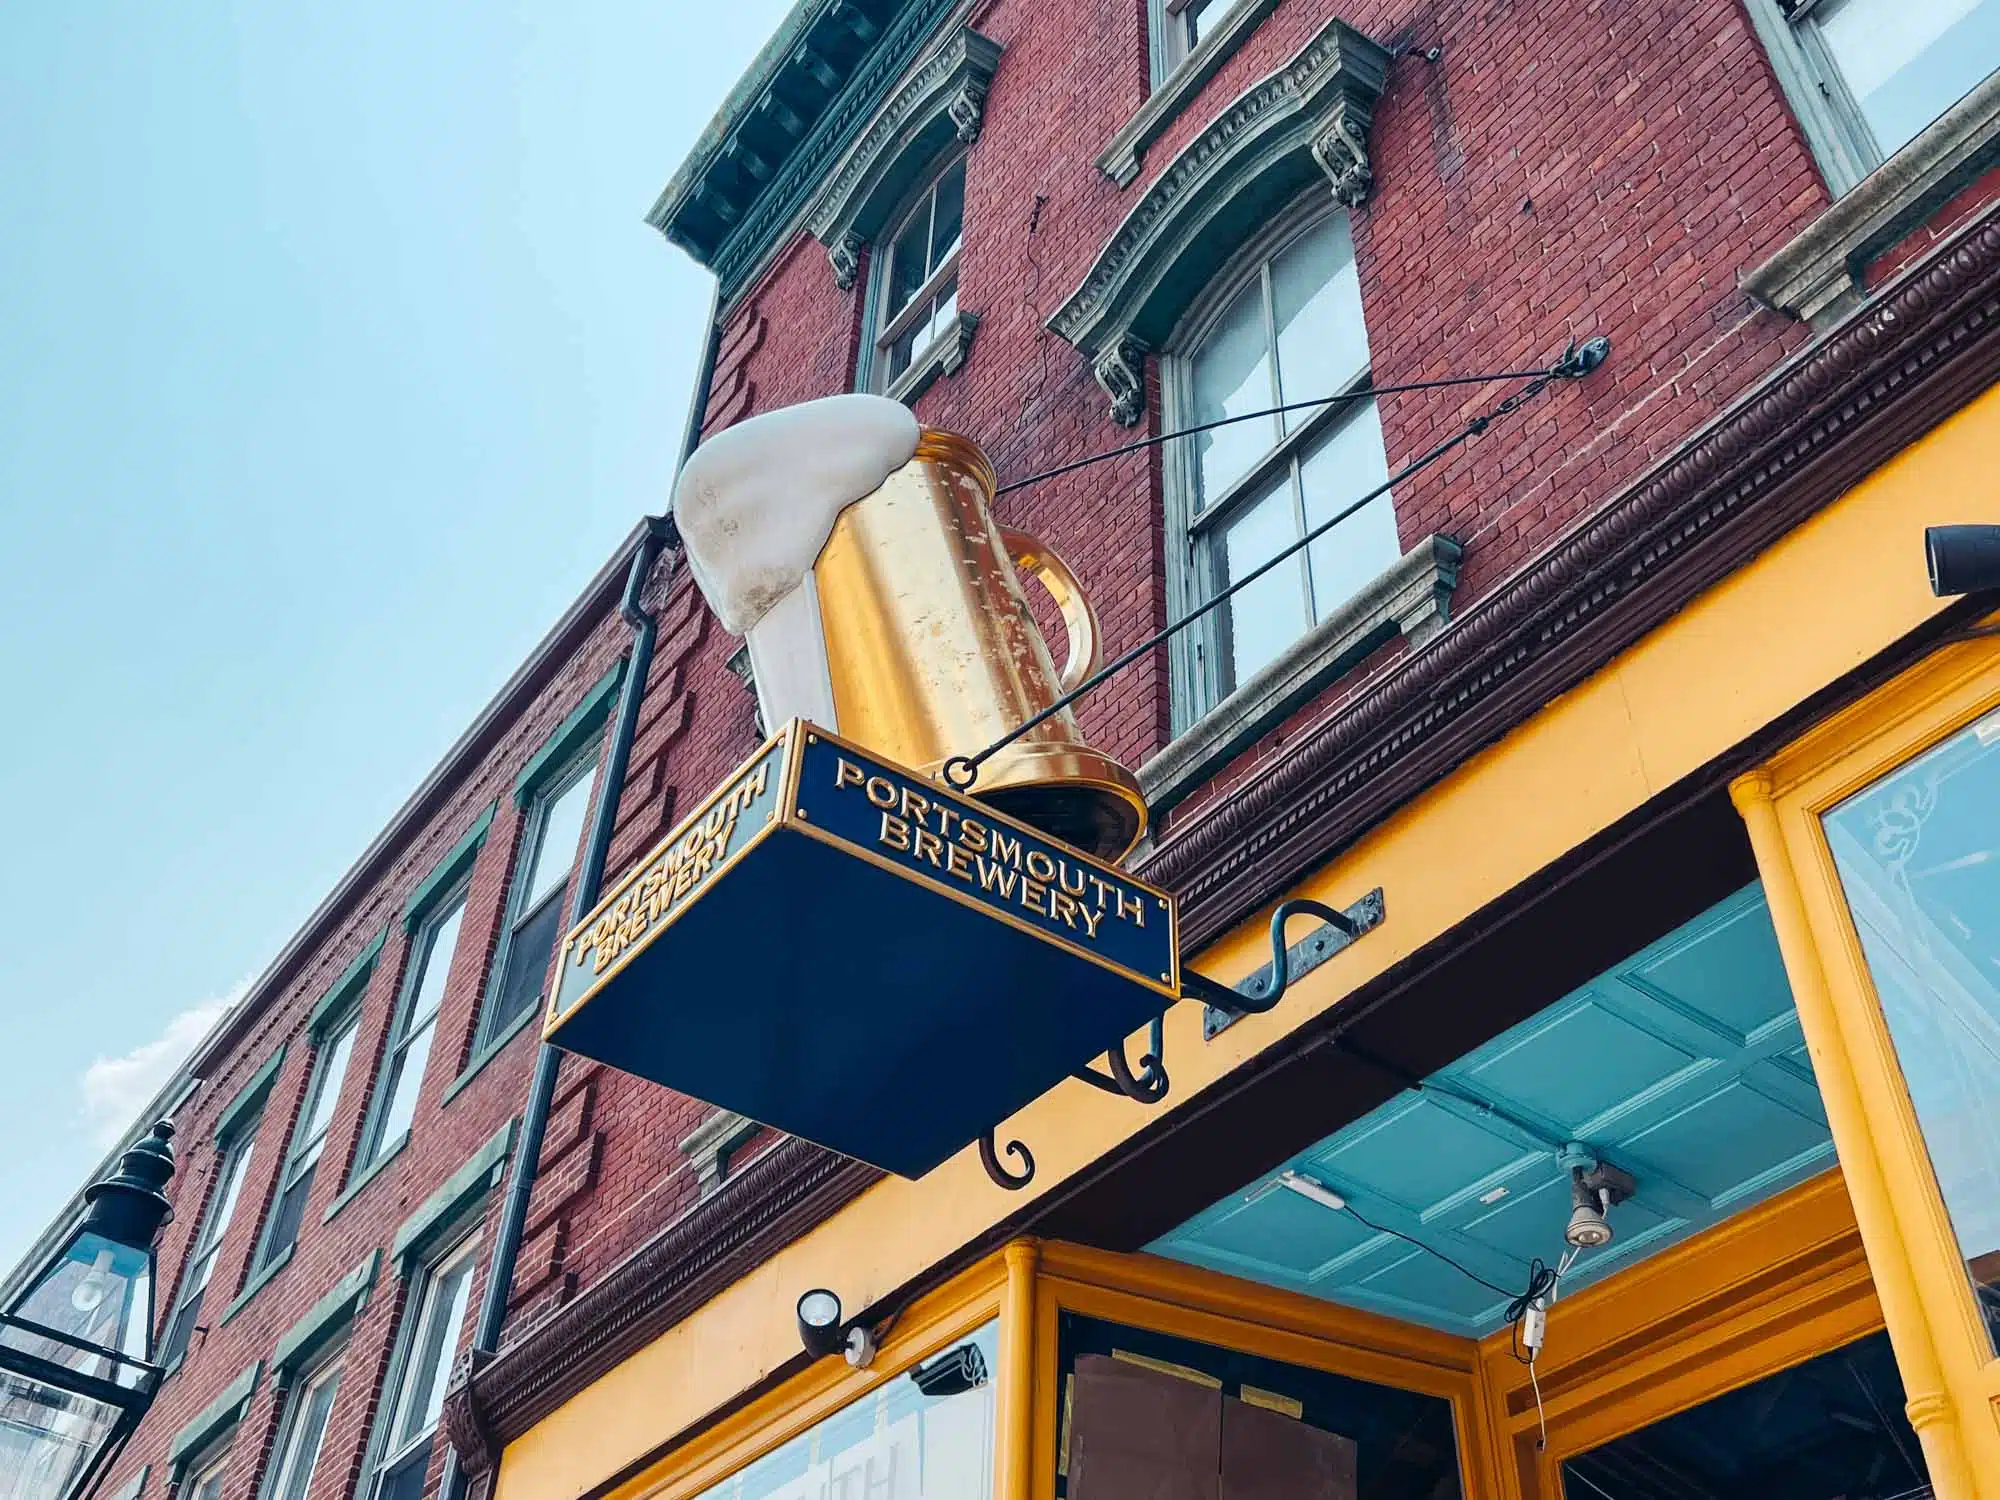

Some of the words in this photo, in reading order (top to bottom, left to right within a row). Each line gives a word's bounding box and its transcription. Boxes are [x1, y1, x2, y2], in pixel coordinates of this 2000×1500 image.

[575, 762, 769, 966] PORTSMOUTH
[593, 818, 737, 974] BREWERY
[835, 757, 1146, 928] PORTSMOUTH
[879, 811, 1105, 938] BREWERY
